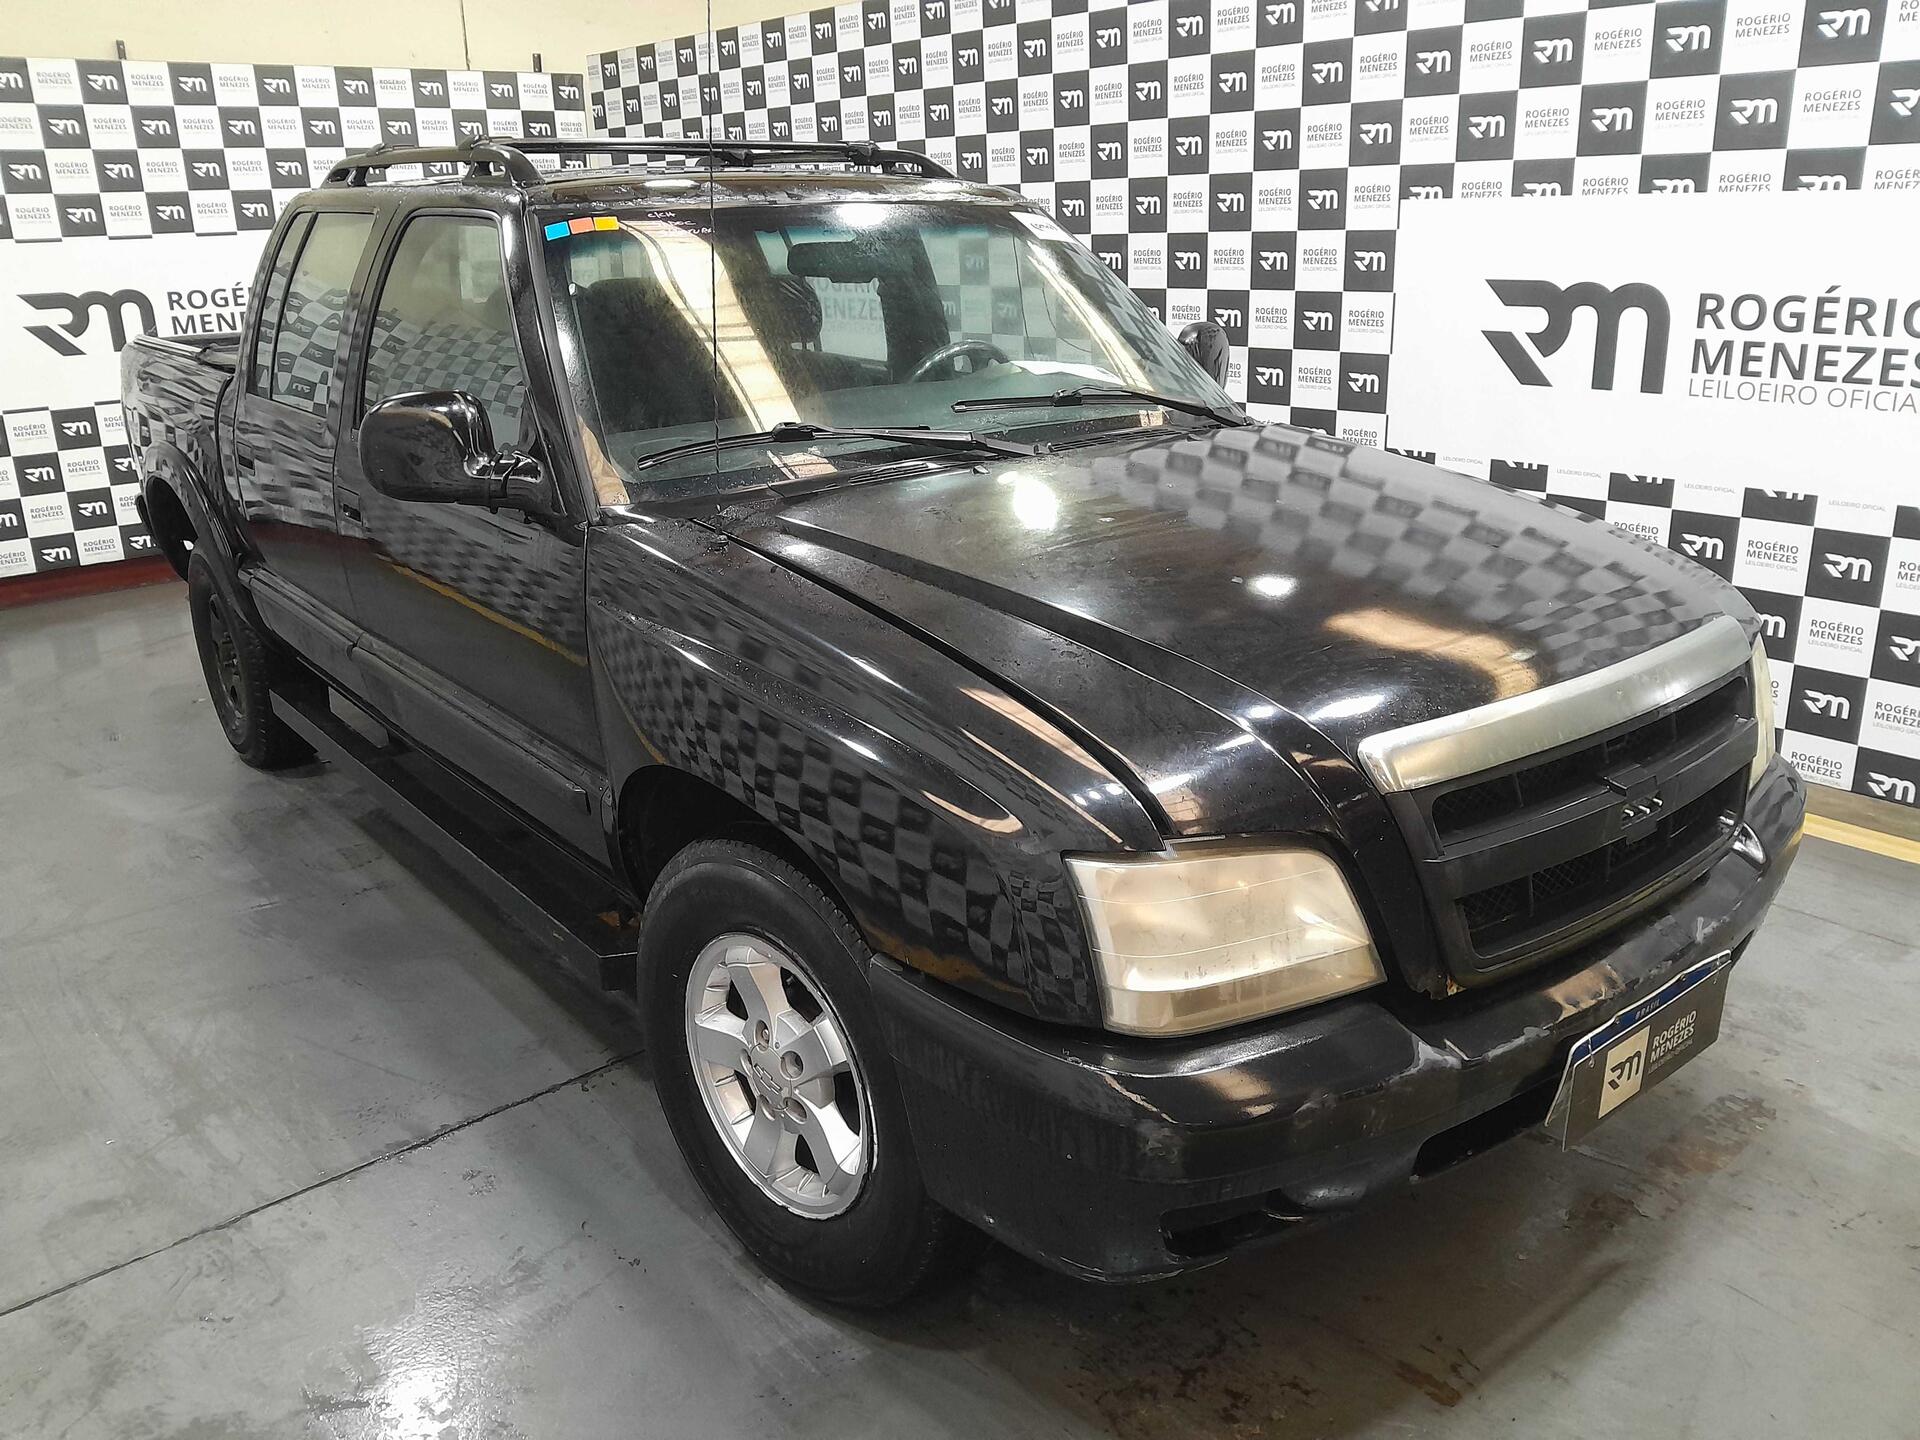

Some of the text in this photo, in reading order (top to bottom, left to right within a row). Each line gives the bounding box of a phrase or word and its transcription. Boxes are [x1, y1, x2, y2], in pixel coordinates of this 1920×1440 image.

[1217, 6, 1249, 17] ROGÉRIO
[1311, 0, 1347, 13] MENEZES
[839, 14, 858, 23] ROGÉRIO
[1217, 14, 1250, 26] MENEZES
[1737, 13, 1790, 26] ROGÉRIO
[840, 22, 859, 30] MENEZES
[1133, 19, 1162, 30] ROGÉRIO
[1057, 30, 1083, 40] ROGÉRIO
[1133, 27, 1162, 38] MENEZES
[1593, 28, 1642, 40] ROGÉRIO
[1736, 24, 1789, 38] MENEZES
[988, 41, 1012, 50] ROGÉRIO
[1057, 38, 1084, 48] MENEZES
[1470, 41, 1512, 52] ROGÉRIO
[1594, 38, 1641, 51] MENEZES
[988, 48, 1012, 57] MENEZES
[1470, 50, 1512, 62] MENEZES
[1360, 52, 1397, 64] ROGÉRIO
[1262, 64, 1295, 74] ROGÉRIO
[1360, 62, 1397, 73] MENEZES
[1174, 73, 1204, 84] ROGÉRIO
[1262, 72, 1295, 83] MENEZES
[1095, 82, 1122, 92] ROGÉRIO
[1174, 82, 1204, 91] MENEZES
[1023, 90, 1048, 99] ROGÉRIO
[1095, 90, 1122, 100] MENEZES
[1805, 89, 1861, 101] ROGÉRIO
[958, 98, 980, 106] ROGÉRIO
[1024, 98, 1048, 106] MENEZES
[1656, 99, 1705, 110] ROGÉRIO
[1804, 101, 1860, 112] MENEZES
[1526, 108, 1569, 118] ROGÉRIO
[1655, 110, 1704, 120] MENEZES
[1410, 116, 1449, 126] ROGÉRIO
[1525, 118, 1569, 128] MENEZES
[1308, 123, 1342, 133] ROGÉRIO
[1410, 125, 1448, 135] MENEZES
[1216, 130, 1247, 139] ROGÉRIO
[1307, 132, 1342, 142] MENEZES
[1134, 136, 1162, 145] ROGÉRIO
[1216, 138, 1247, 148] MENEZES
[1059, 142, 1084, 150] ROGÉRIO
[1134, 144, 1162, 152] MENEZES
[1059, 150, 1085, 158] MENEZES
[1583, 176, 1628, 187] ROGÉRIO
[1720, 173, 1771, 183] ROGÉRIO
[1354, 184, 1391, 194] ROGÉRIO
[1462, 180, 1502, 190] ROGÉRIO
[1173, 191, 1202, 200] ROGÉRIO
[1259, 187, 1291, 196] ROGÉRIO
[1096, 194, 1122, 202] ROGÉRIO
[1259, 197, 1291, 205] MENEZES
[1354, 194, 1391, 202] MENEZES
[1173, 200, 1202, 208] MENEZES
[1134, 248, 1161, 256] ROGÉRIO
[1214, 248, 1244, 256] ROGÉRIO
[1303, 248, 1337, 256] ROGÉRIO
[1303, 257, 1337, 265] MENEZES
[1172, 304, 1200, 312] ROGÉRIO
[1256, 306, 1287, 315] ROGÉRIO
[1349, 309, 1384, 318] ROGÉRIO
[1255, 315, 1287, 324] MENEZES
[1348, 318, 1384, 327] MENEZES
[1298, 366, 1331, 376] ROGÉRIO
[1298, 375, 1331, 384] MENEZES
[1689, 378, 1817, 405] LEILOEIRO
[1342, 428, 1377, 438] ROGÉRIO
[1614, 521, 1659, 535] ROGÉRIO
[1748, 540, 1798, 554] ROGÉRIO
[1746, 549, 1798, 564] MENEZES
[1811, 619, 1864, 636] ROGÉRIO
[1809, 628, 1863, 645] MENEZES
[1791, 751, 1842, 769] ROGÉRIO
[1791, 760, 1841, 779] MENEZES
[1653, 1011, 1696, 1048] ROGÉRIO
[1651, 1023, 1694, 1062] MENEZES
